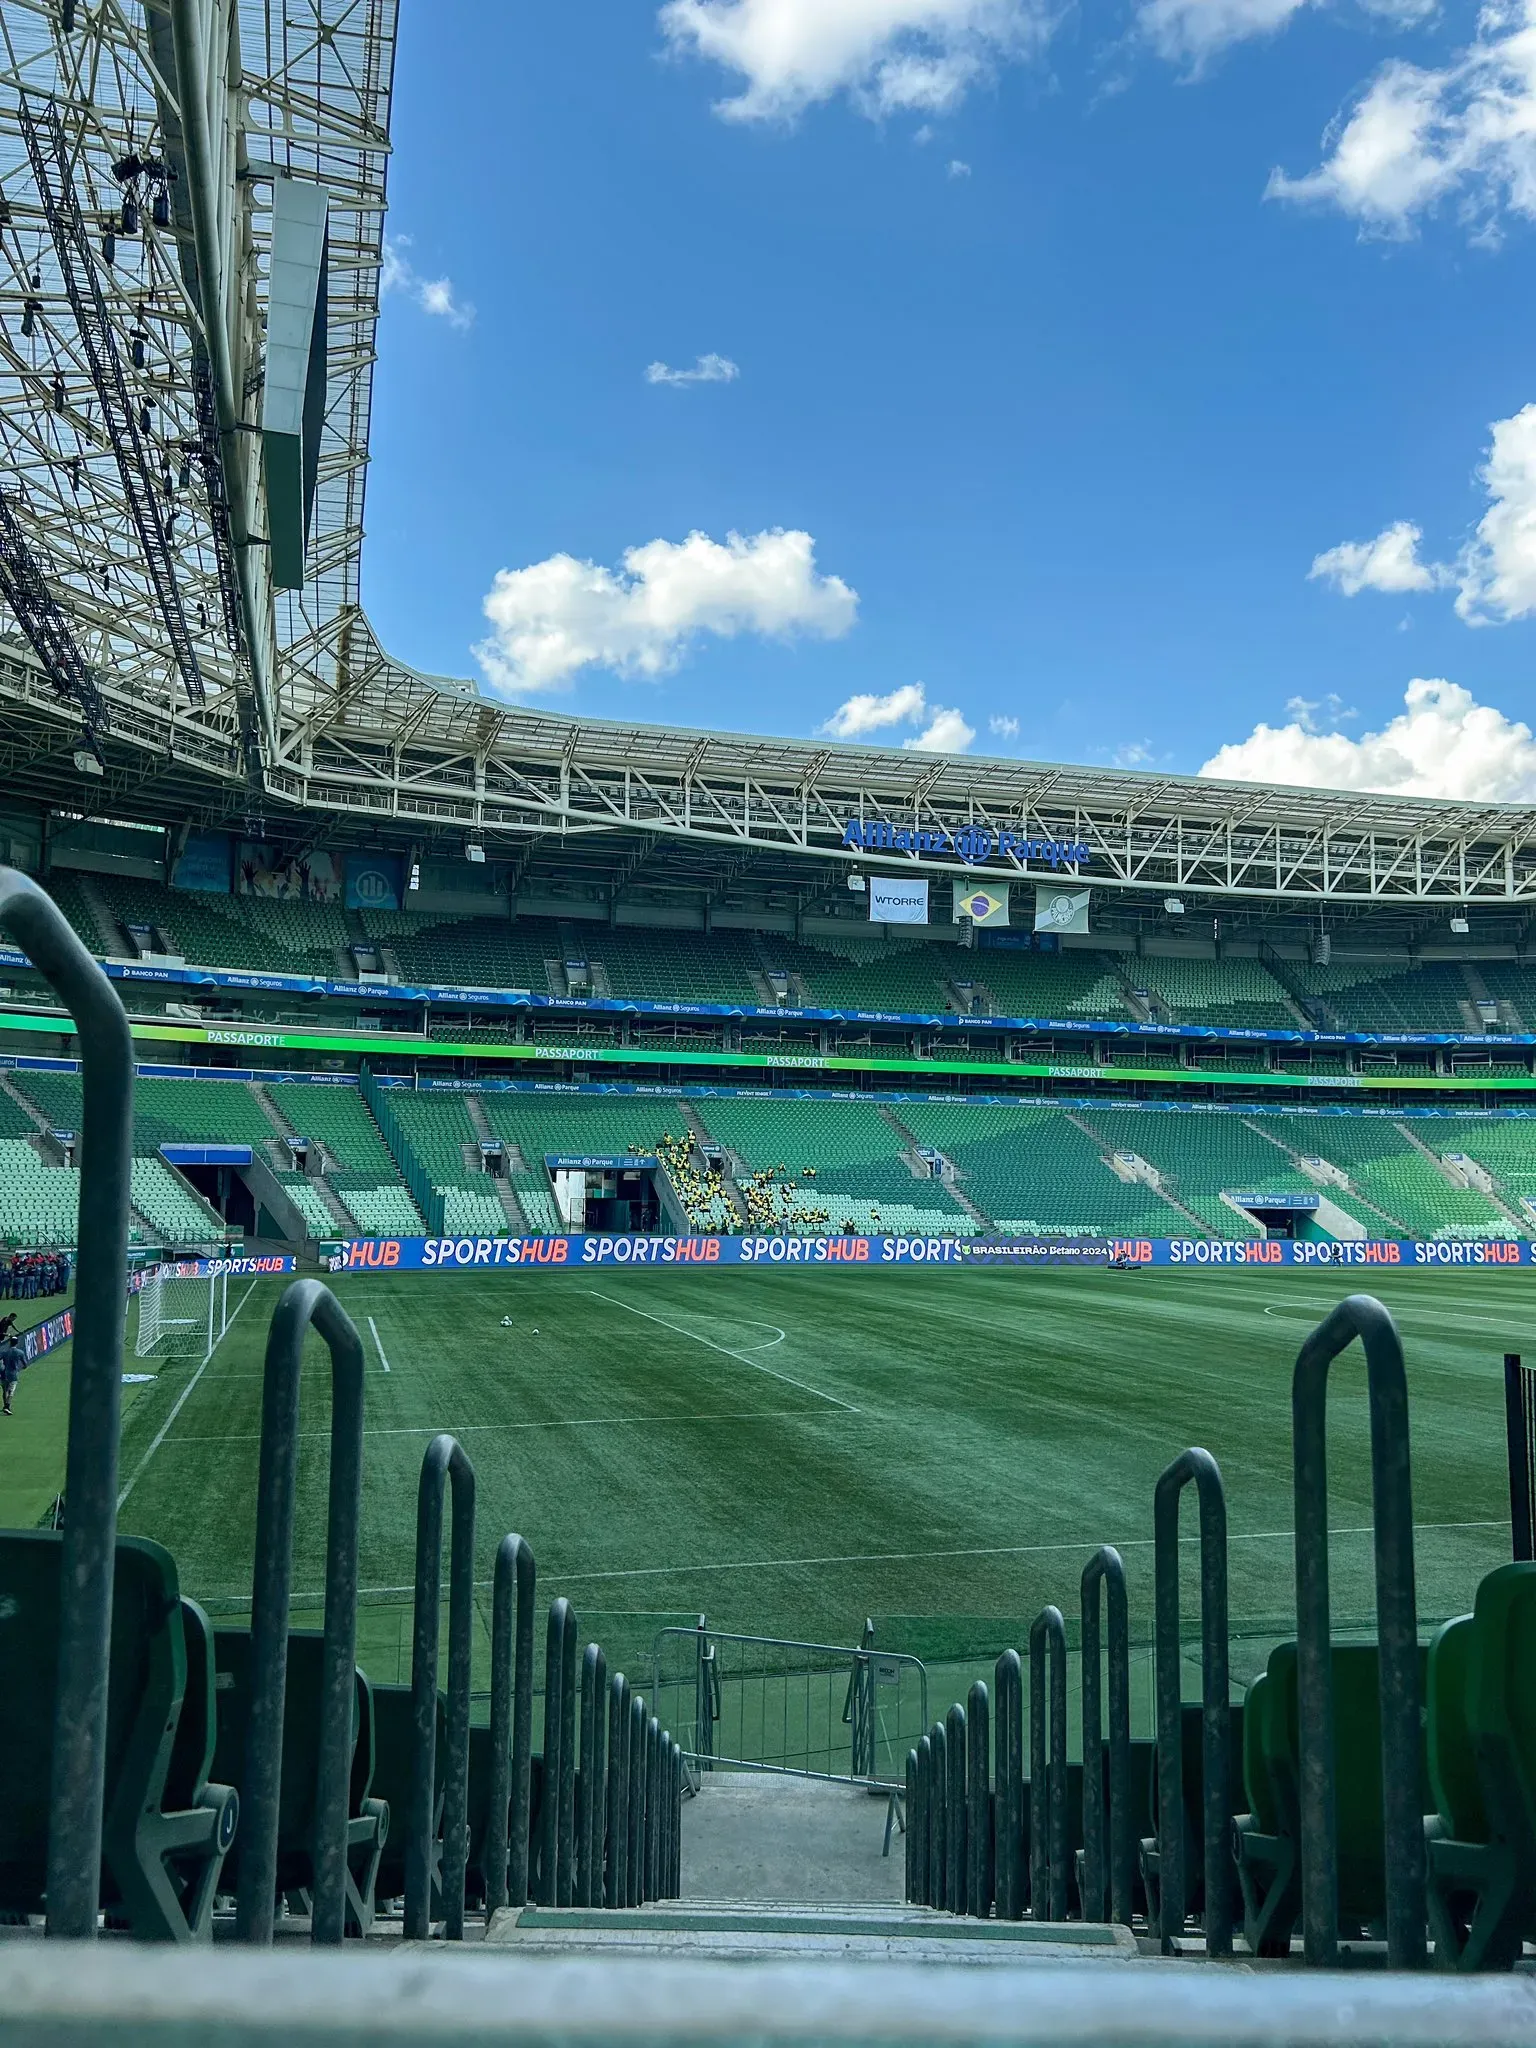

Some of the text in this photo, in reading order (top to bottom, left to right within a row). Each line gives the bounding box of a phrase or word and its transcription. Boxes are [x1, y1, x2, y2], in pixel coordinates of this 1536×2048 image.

[842, 819, 1090, 868] Allianz Parque
[875, 895, 924, 906] WTORRE
[0, 955, 23, 964] Allianz
[132, 970, 168, 979] BANCO PAN
[227, 976, 282, 987] Allianz Seguros
[334, 985, 388, 995] Allianz Parque
[438, 992, 489, 1002] Allianz Seguros
[679, 1005, 699, 1013] Seguros
[756, 1008, 776, 1016] Allianz
[1493, 1035, 1512, 1043] Parque
[561, 1084, 580, 1092] Parque
[557, 1157, 613, 1167] Allianz Parque
[1264, 1196, 1286, 1205] Parque
[421, 1238, 568, 1265] SPORTSHUB
[582, 1237, 720, 1262] SPORTSHUB
[740, 1237, 869, 1261] SPORTSHUB
[973, 1245, 1107, 1256] BRASILEIRÃO Betano 2024
[1169, 1240, 1283, 1263] SPORTSHUB
[1293, 1241, 1400, 1263] SPORTSHUB
[1415, 1242, 1520, 1263] SPORTSHUB
[207, 1257, 284, 1274] SPORTSHUB
